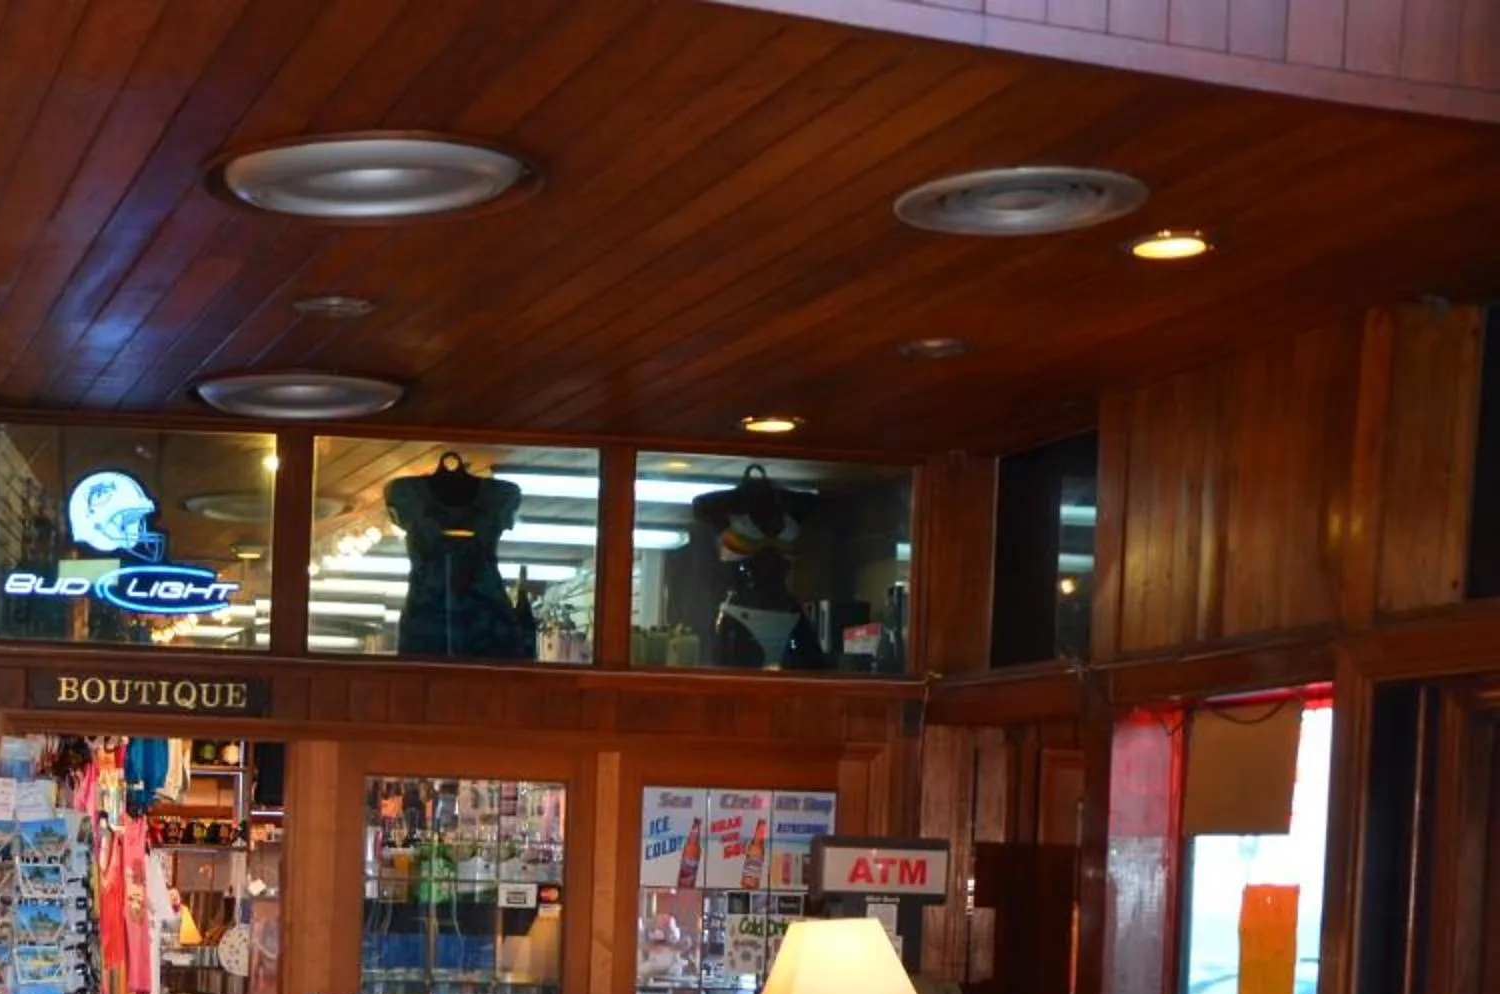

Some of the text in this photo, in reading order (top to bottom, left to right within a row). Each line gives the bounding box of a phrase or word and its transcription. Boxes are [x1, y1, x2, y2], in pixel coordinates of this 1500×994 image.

[4, 573, 239, 600] BUD LIGHT
[57, 676, 248, 709] BOUTIQUE
[649, 816, 671, 836] ICE
[847, 856, 928, 886] ATM
